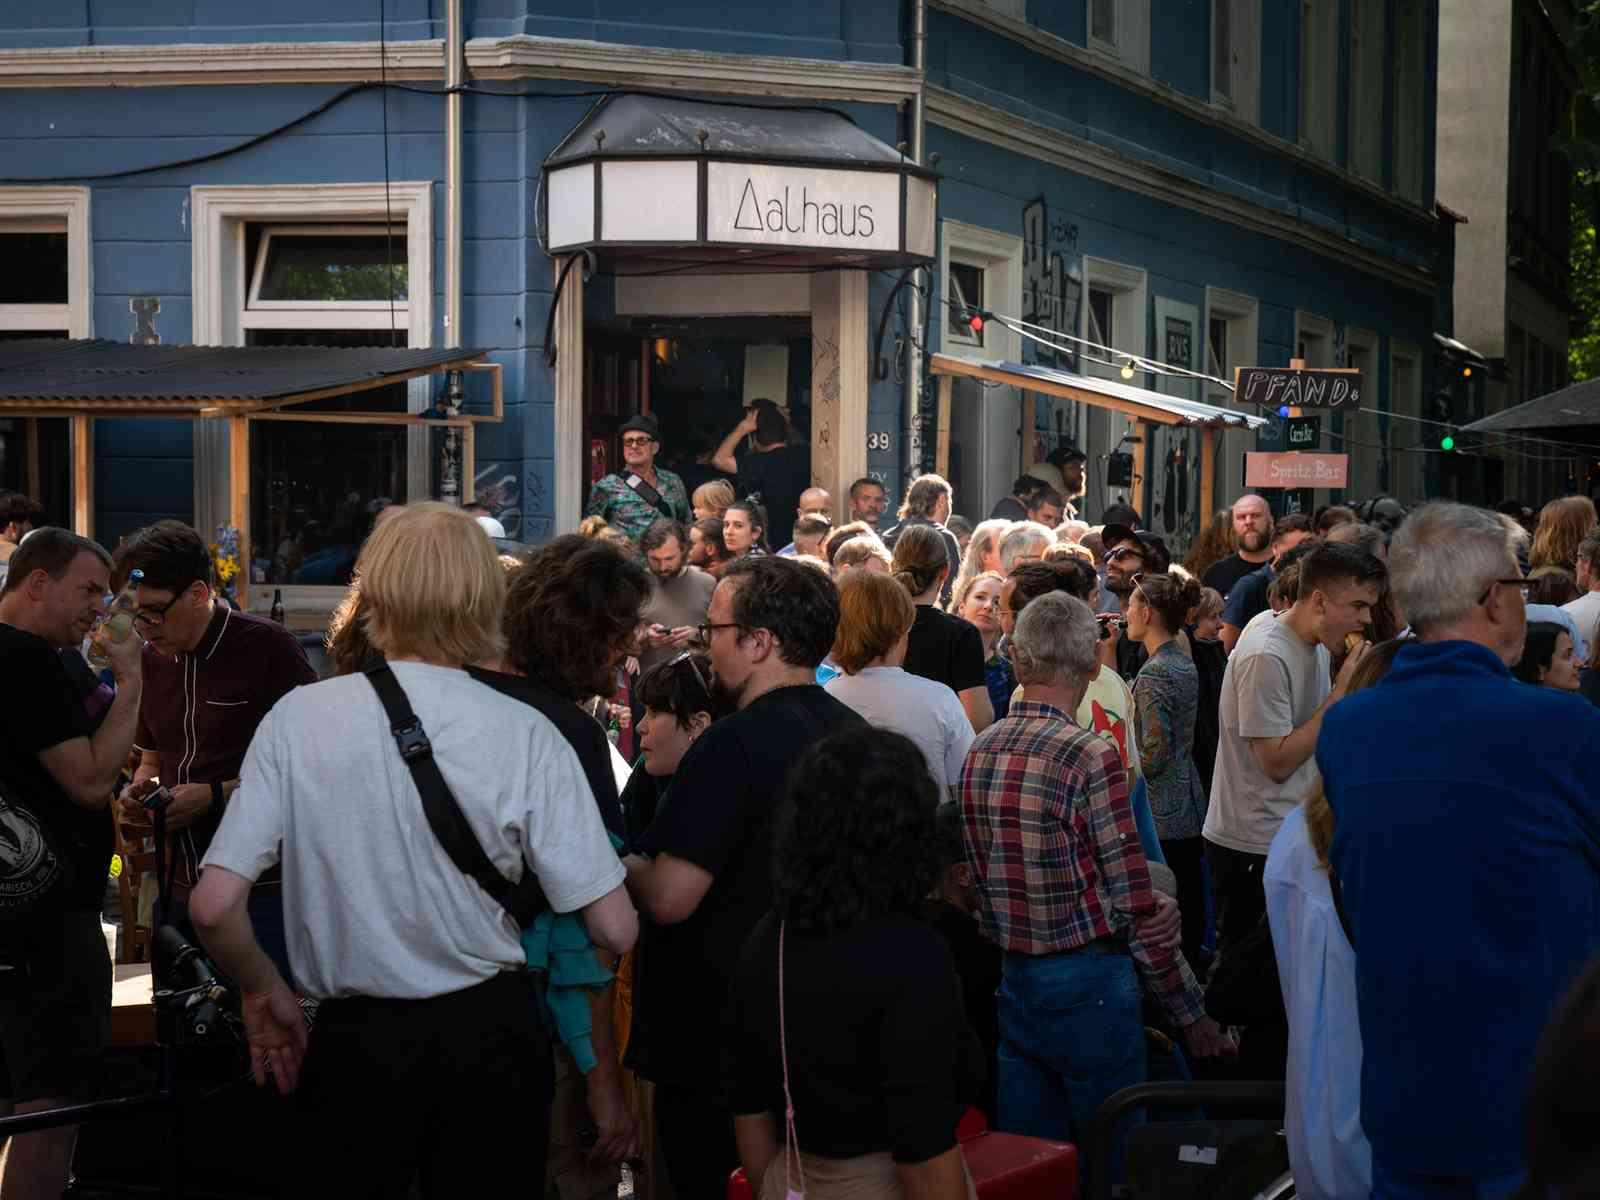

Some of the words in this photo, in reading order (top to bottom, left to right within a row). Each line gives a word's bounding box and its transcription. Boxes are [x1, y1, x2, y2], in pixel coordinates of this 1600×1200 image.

[734, 178, 875, 238] Aalhaus
[1244, 371, 1349, 406] PFAND
[868, 432, 889, 449] 39
[1271, 460, 1312, 484] Spritz
[1315, 460, 1340, 479] Bar
